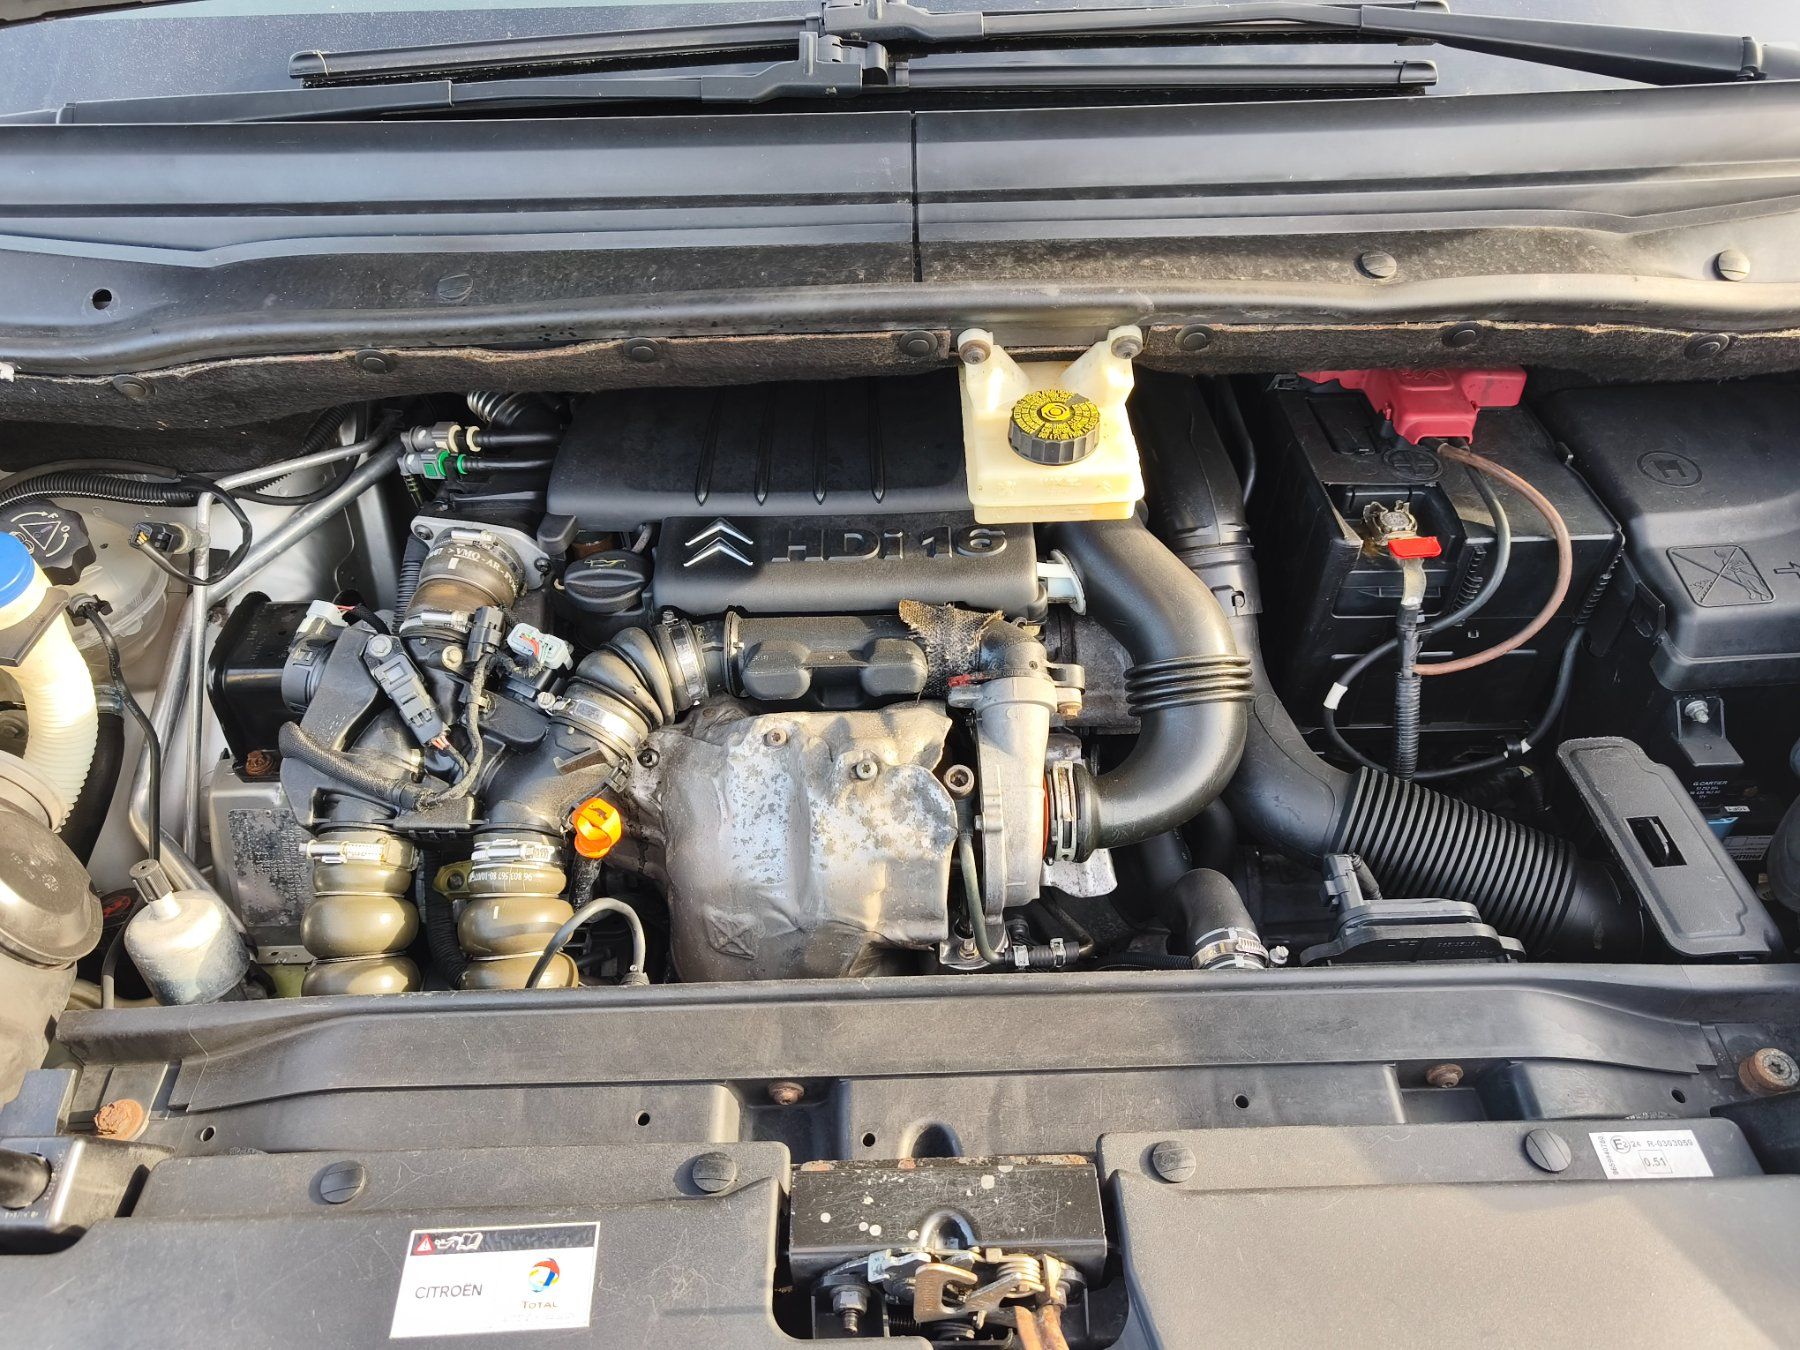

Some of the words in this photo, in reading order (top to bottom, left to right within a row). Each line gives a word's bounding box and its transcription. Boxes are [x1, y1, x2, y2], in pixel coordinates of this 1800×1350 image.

[771, 527, 904, 562] HDi
[920, 525, 1008, 558] 16
[1644, 1157, 1667, 1167] 0.51
[415, 1284, 482, 1299] CITROËN
